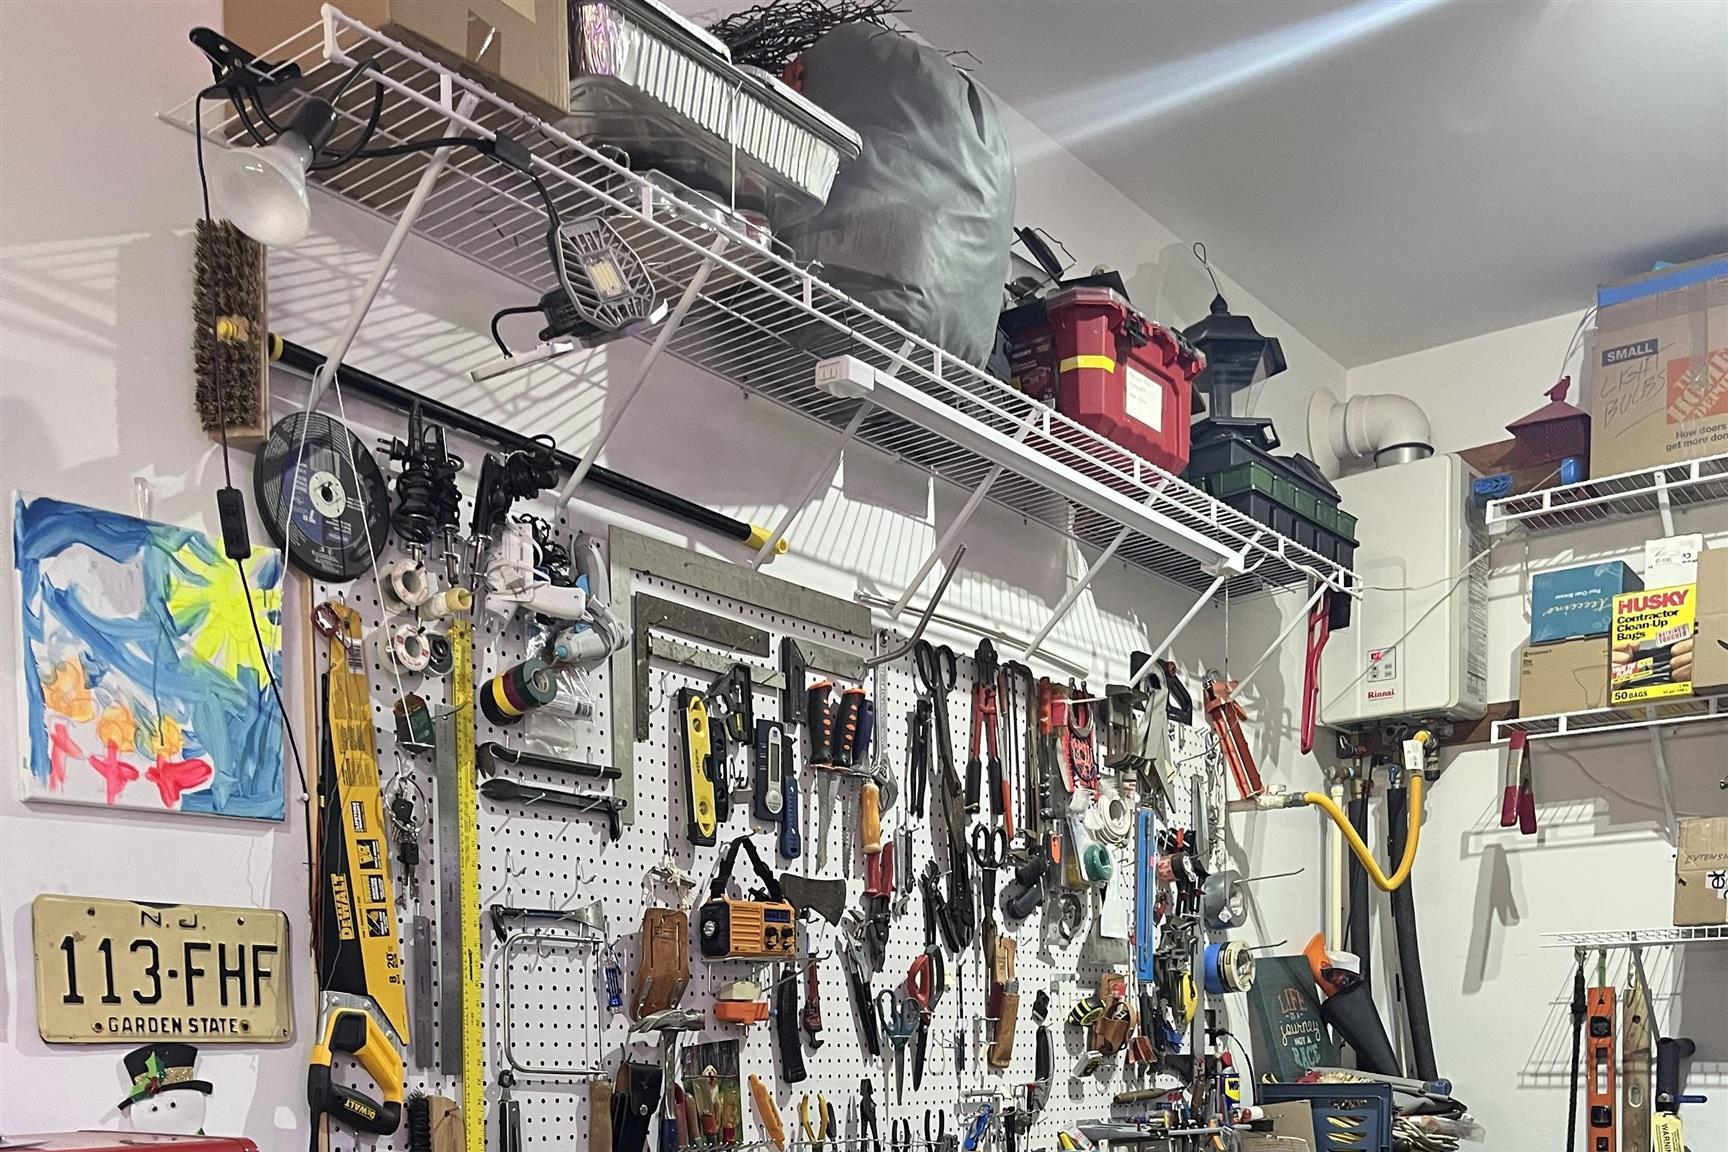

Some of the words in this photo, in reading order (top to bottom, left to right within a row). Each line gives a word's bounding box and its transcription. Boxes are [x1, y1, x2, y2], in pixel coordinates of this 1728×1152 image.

[1607, 343, 1654, 362] SMALL
[1600, 353, 1659, 398] LIGHT
[1602, 368, 1667, 429] BULBS
[1676, 429, 1697, 440] How
[1700, 423, 1727, 434] doers
[1665, 441, 1681, 452] get
[1684, 436, 1708, 447] more
[1618, 588, 1689, 615] HUSKY
[1617, 609, 1679, 624] Contractor
[1617, 631, 1646, 640] Bags
[1368, 688, 1395, 699] Rinnai
[1614, 691, 1628, 700] 50
[1628, 691, 1648, 699] BAGS
[61, 935, 278, 1006] 113-FHF
[108, 1016, 183, 1034] GARDEN
[189, 1016, 238, 1034] STATE
[1279, 1020, 1320, 1047] journey
[1294, 1036, 1306, 1046] NOT
[1291, 1044, 1321, 1069] RACE
